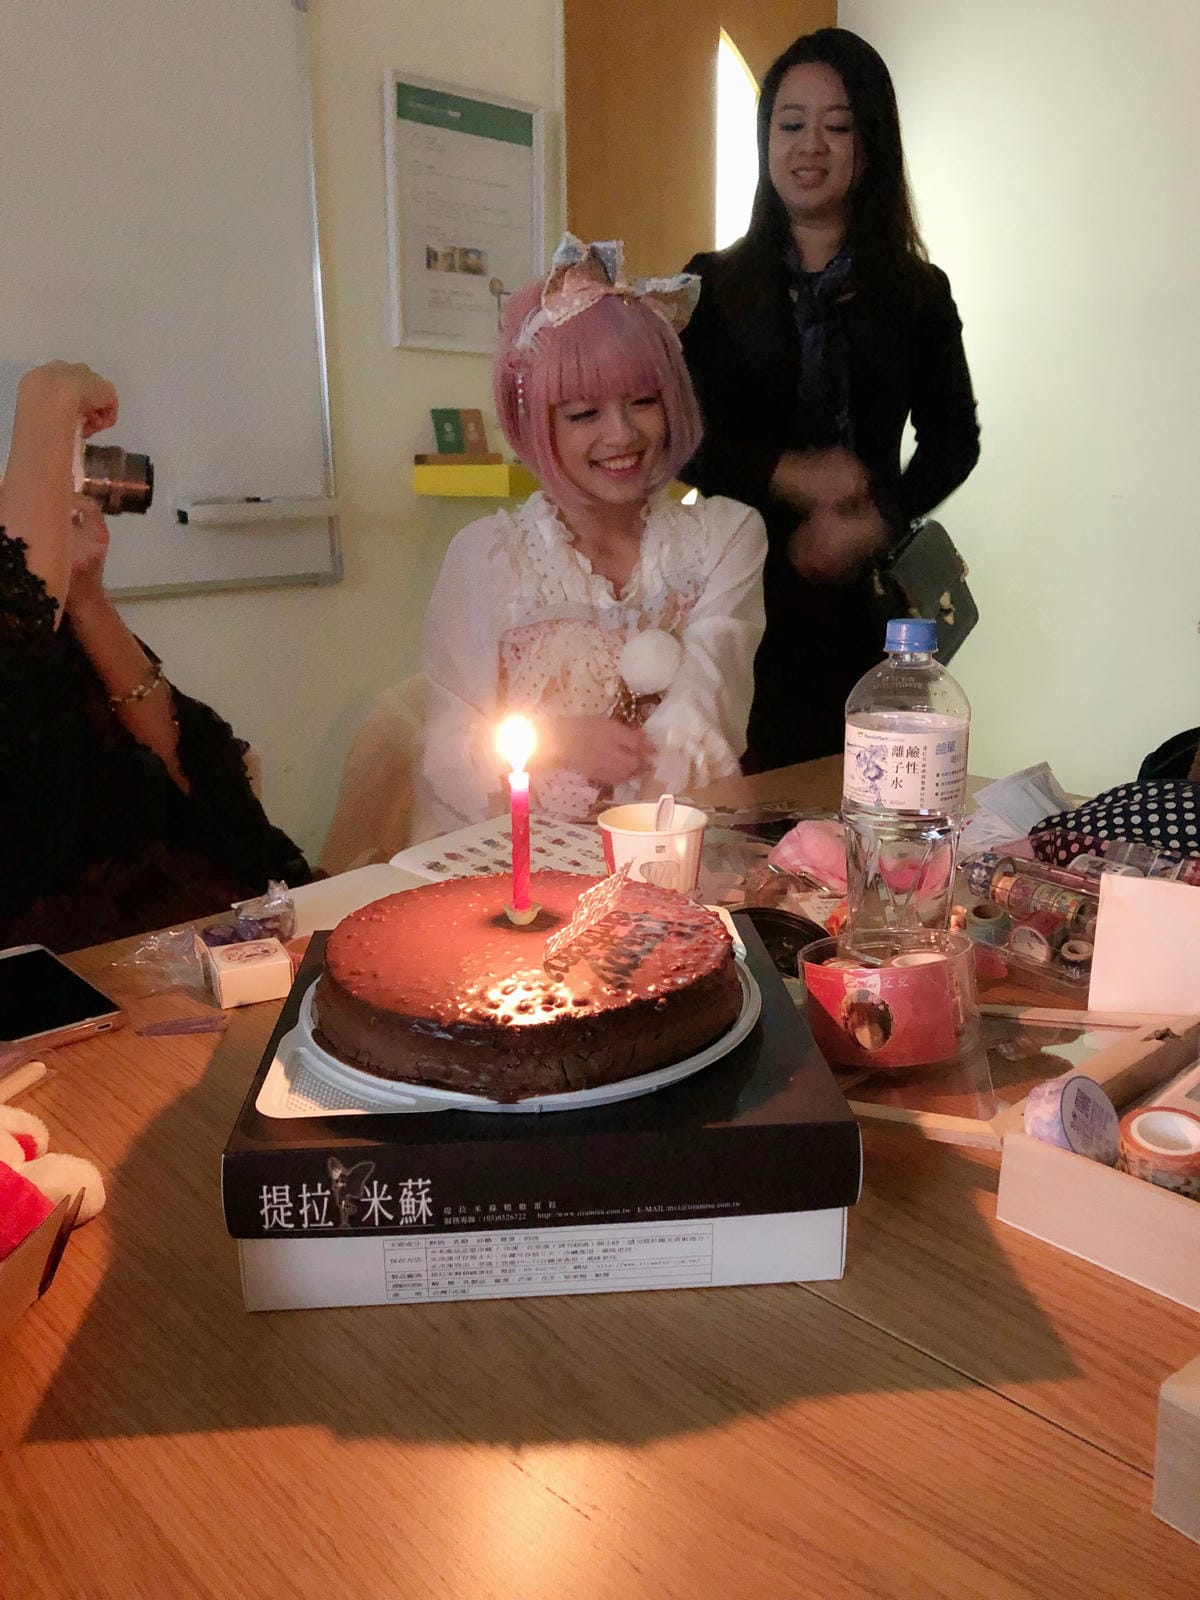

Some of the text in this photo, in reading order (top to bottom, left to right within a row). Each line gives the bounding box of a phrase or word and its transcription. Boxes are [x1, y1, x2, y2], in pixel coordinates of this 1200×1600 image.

[891, 745, 904, 789] 離子水
[905, 745, 920, 774] 鹼性
